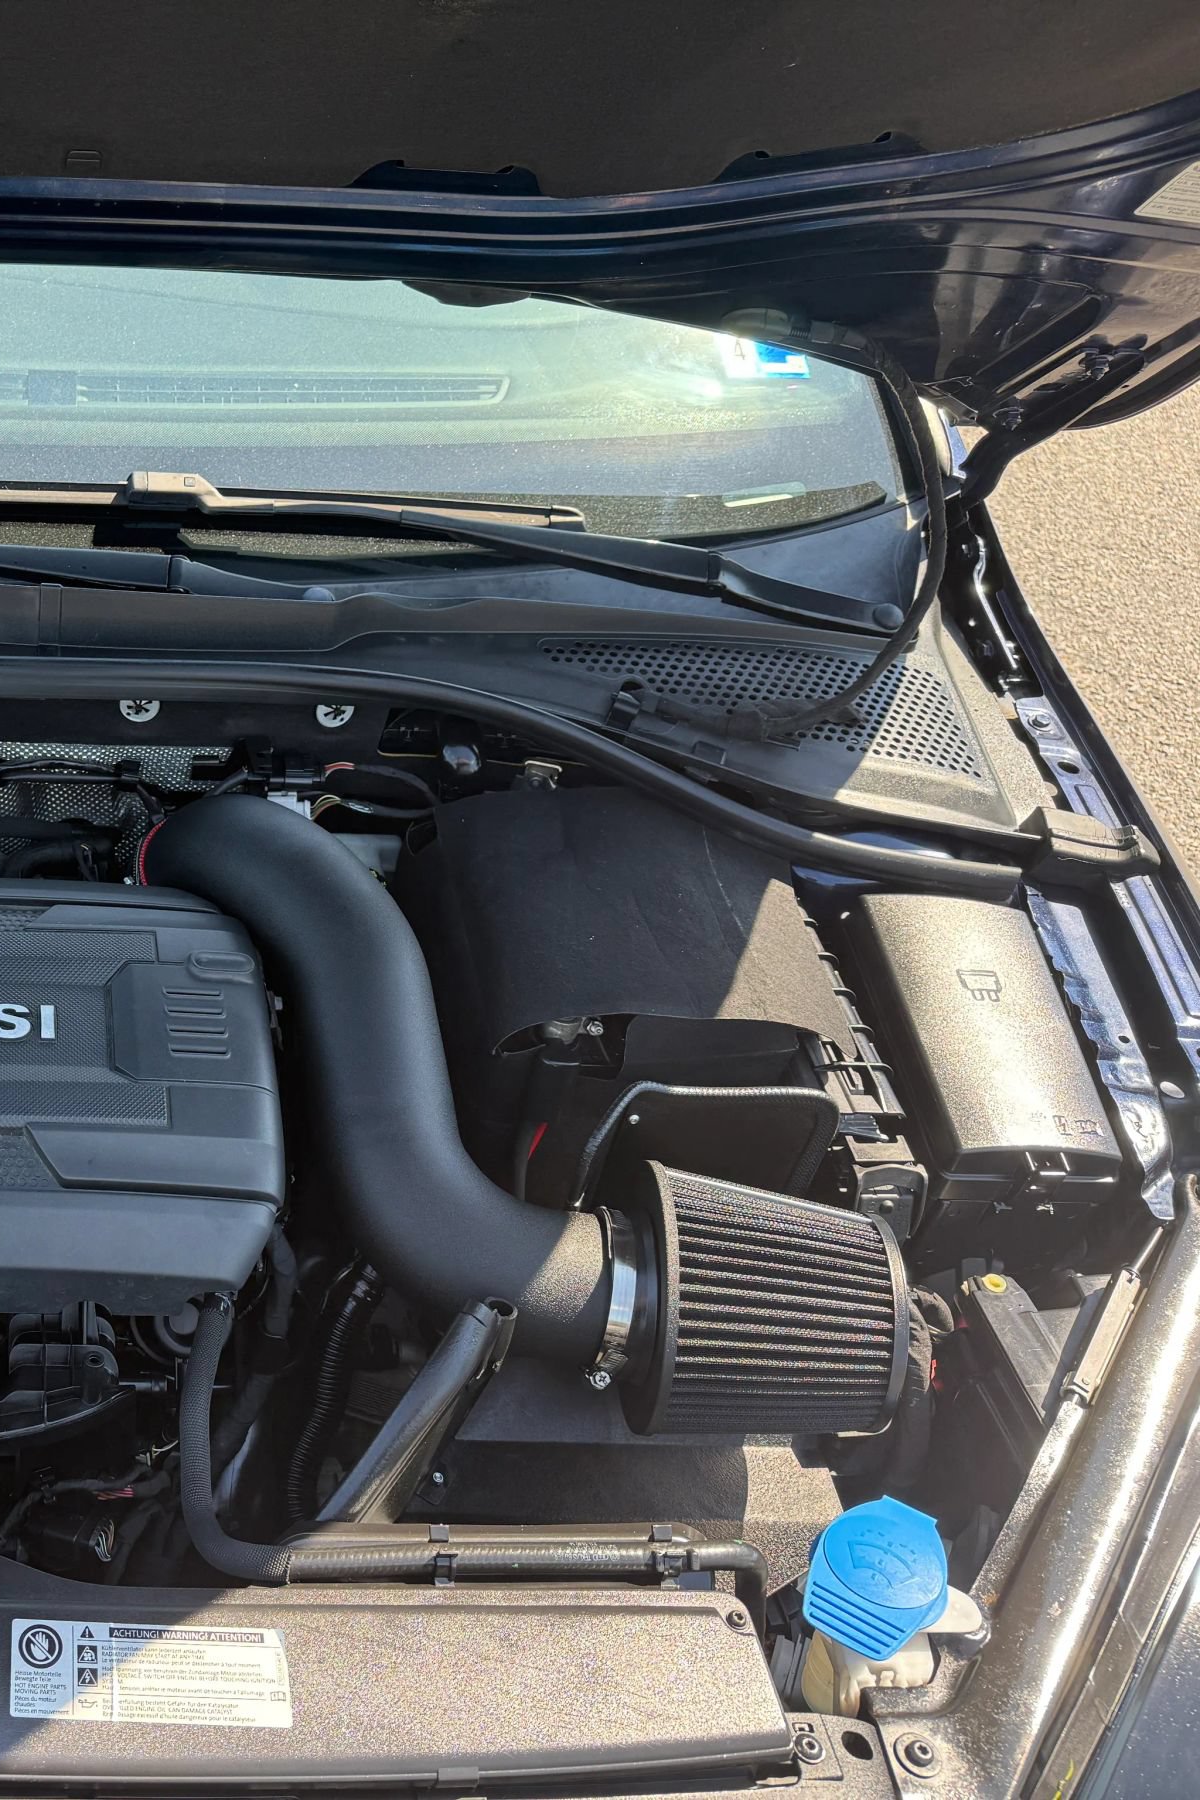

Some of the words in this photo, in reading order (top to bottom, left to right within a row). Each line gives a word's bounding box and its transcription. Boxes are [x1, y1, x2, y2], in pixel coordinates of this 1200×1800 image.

[111, 1628, 160, 1639] ACHTUNG!
[161, 1630, 208, 1641] WARNING!
[208, 1632, 263, 1643] ATTENTION!
